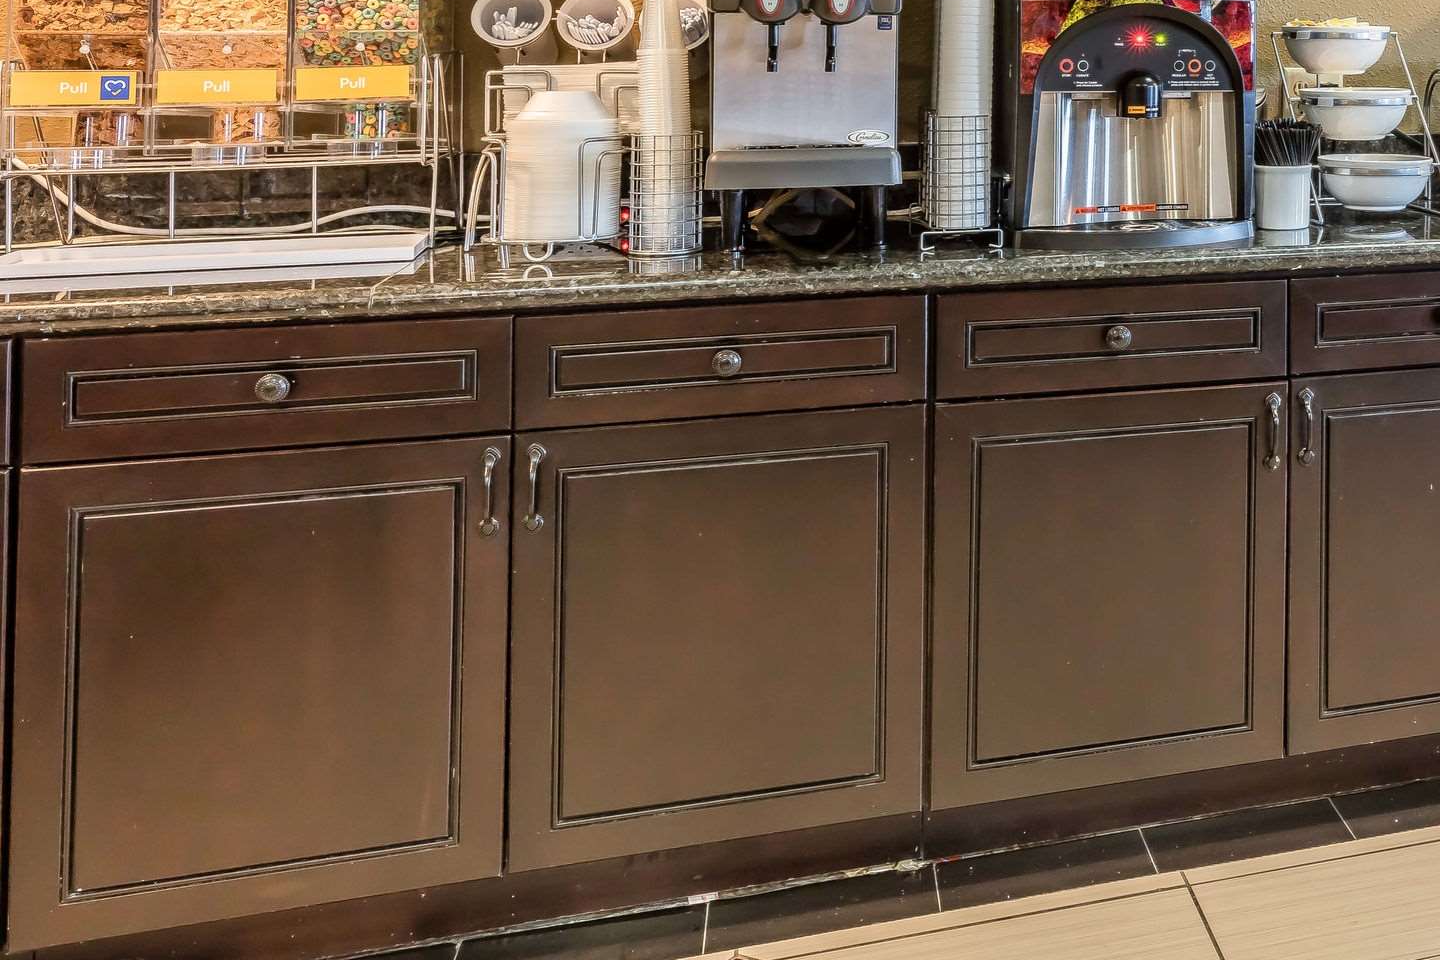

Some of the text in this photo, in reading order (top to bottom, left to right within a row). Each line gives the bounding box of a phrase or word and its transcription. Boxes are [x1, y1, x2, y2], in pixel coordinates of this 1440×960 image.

[59, 82, 88, 95] Pull
[203, 80, 230, 93] Pull
[339, 76, 366, 89] Pull
